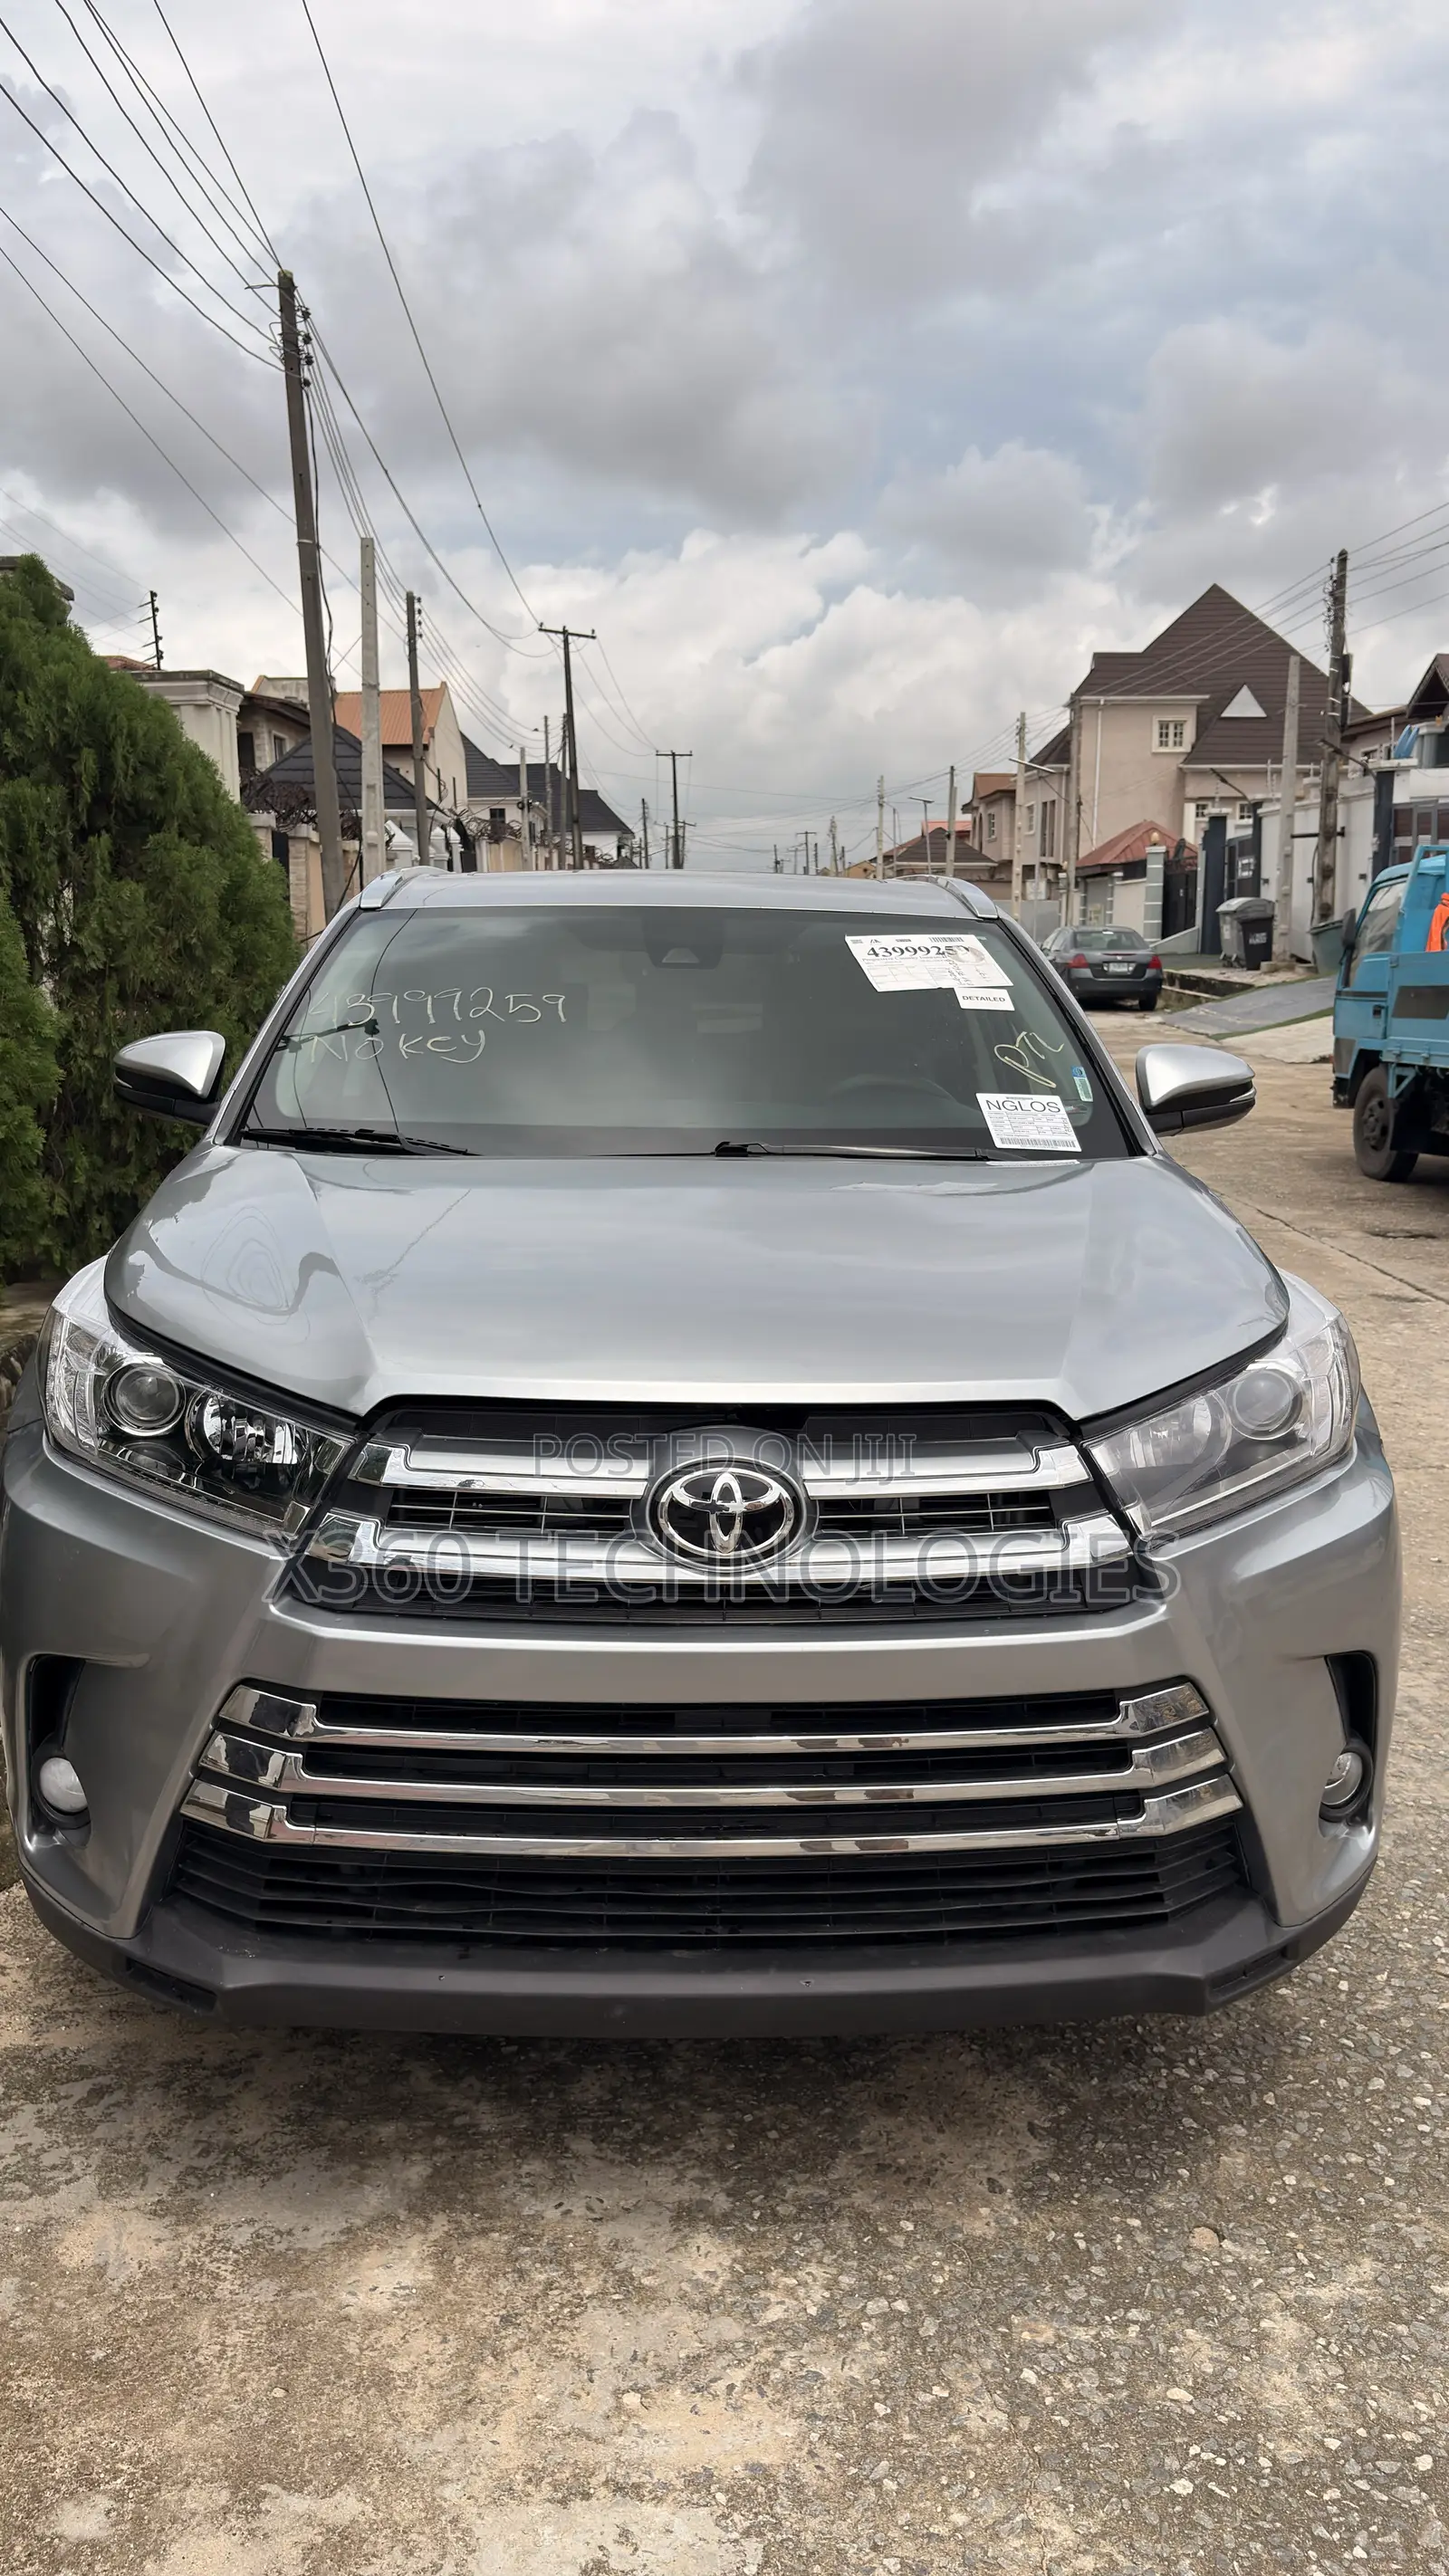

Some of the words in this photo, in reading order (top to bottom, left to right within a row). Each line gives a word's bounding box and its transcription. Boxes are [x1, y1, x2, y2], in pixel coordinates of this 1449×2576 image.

[962, 994, 1006, 1002] DETAILED
[309, 986, 567, 1029] 43999259
[985, 1099, 1061, 1114] NGLOS
